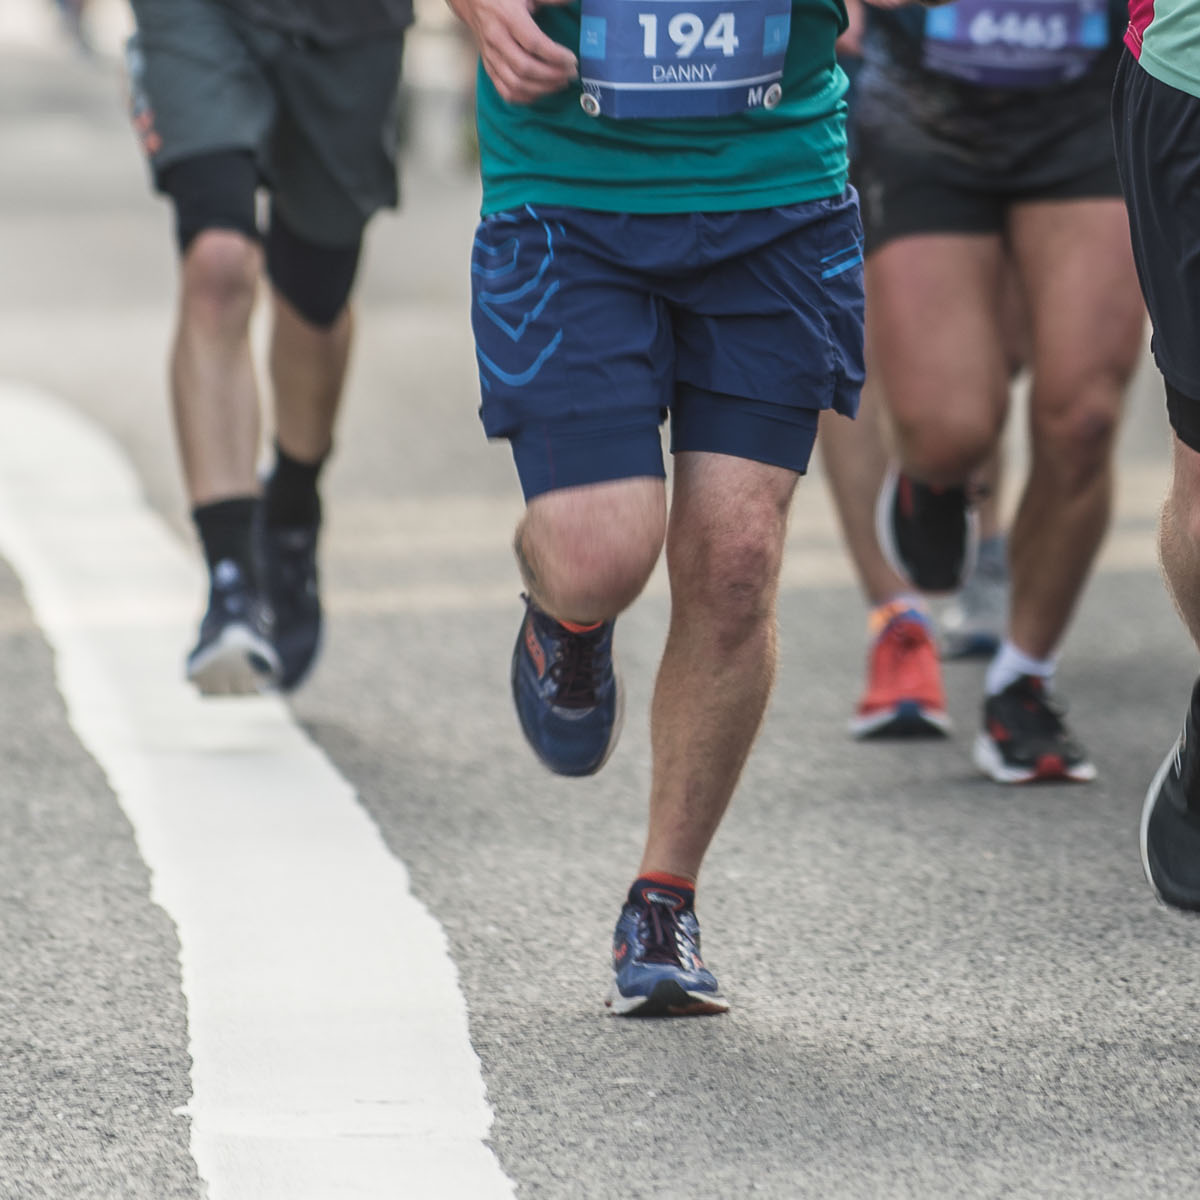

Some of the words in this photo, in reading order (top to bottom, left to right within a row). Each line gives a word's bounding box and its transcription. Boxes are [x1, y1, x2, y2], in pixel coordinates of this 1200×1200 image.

[638, 12, 740, 59] 194
[651, 63, 717, 83] DANNY
[747, 86, 764, 107] M
